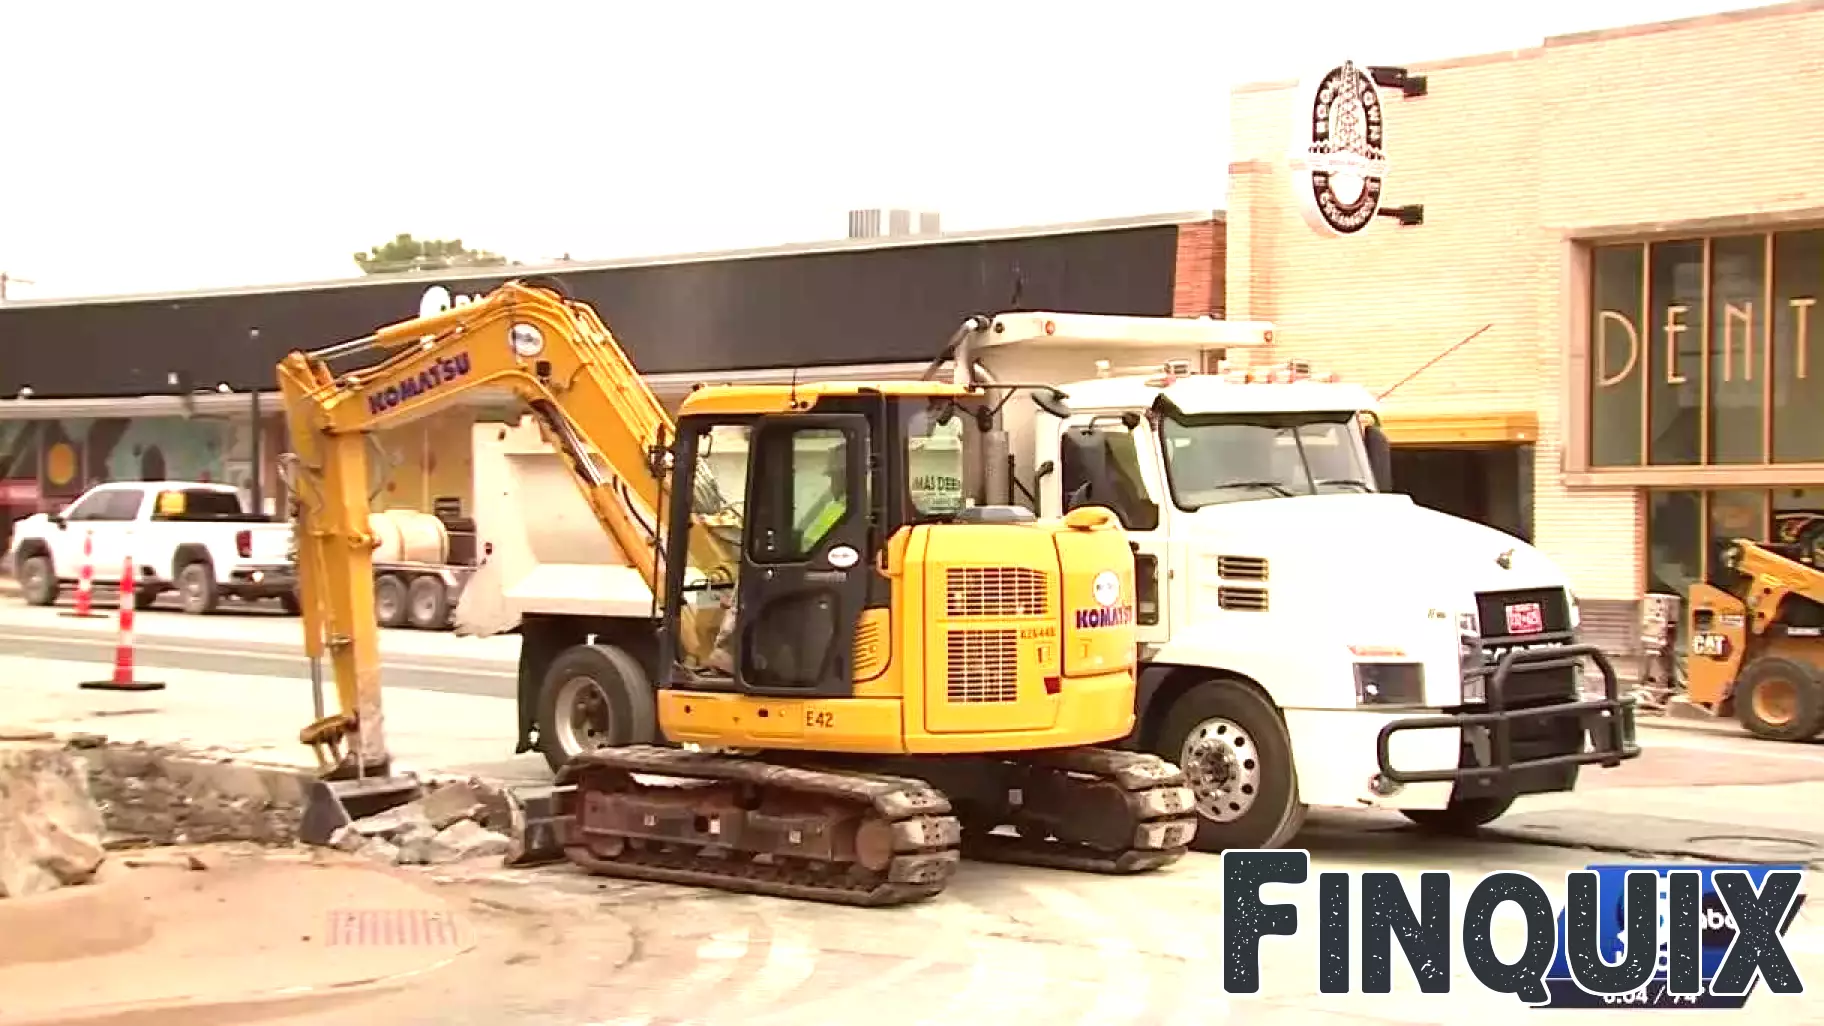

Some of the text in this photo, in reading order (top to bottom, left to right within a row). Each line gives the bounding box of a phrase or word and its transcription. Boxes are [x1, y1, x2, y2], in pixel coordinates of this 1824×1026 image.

[368, 351, 471, 415] KOMATSU
[1693, 635, 1725, 655] CAT
[806, 710, 834, 728] E42
